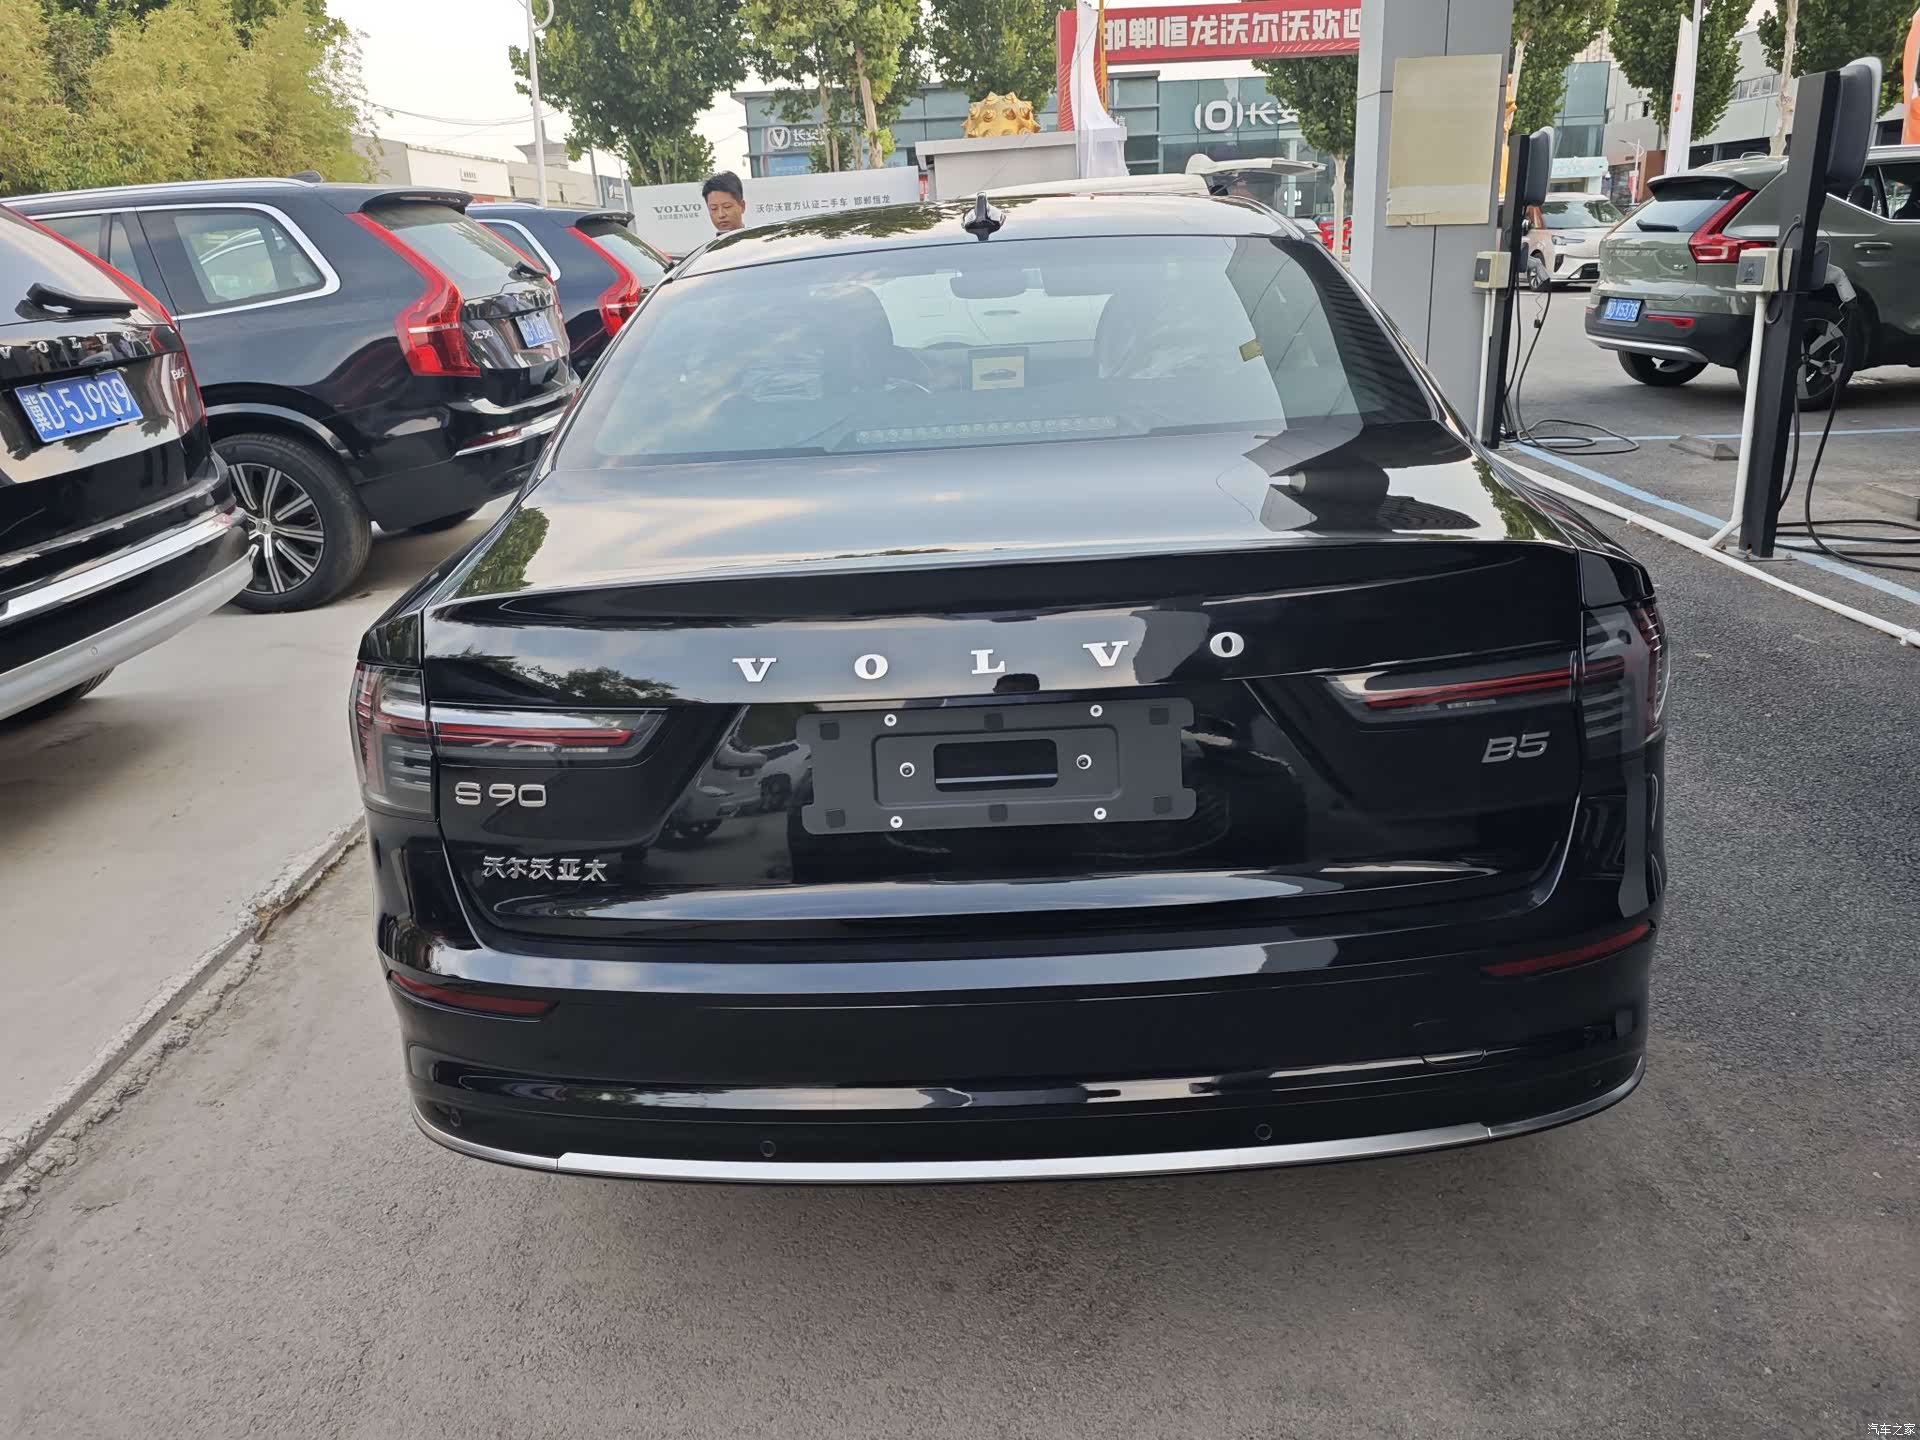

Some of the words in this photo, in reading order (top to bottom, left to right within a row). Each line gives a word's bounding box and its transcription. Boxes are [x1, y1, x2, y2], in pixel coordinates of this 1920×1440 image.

[652, 203, 702, 214] VOLVO
[756, 196, 848, 214] 沃尔沃官方认证二手车
[853, 194, 891, 206] 邯郸恒龙
[470, 329, 494, 341] XC90
[732, 631, 1246, 684] VOLVO
[1481, 731, 1550, 763] B5
[454, 777, 548, 808] S90
[481, 855, 609, 883] 沃尔沃亚太
